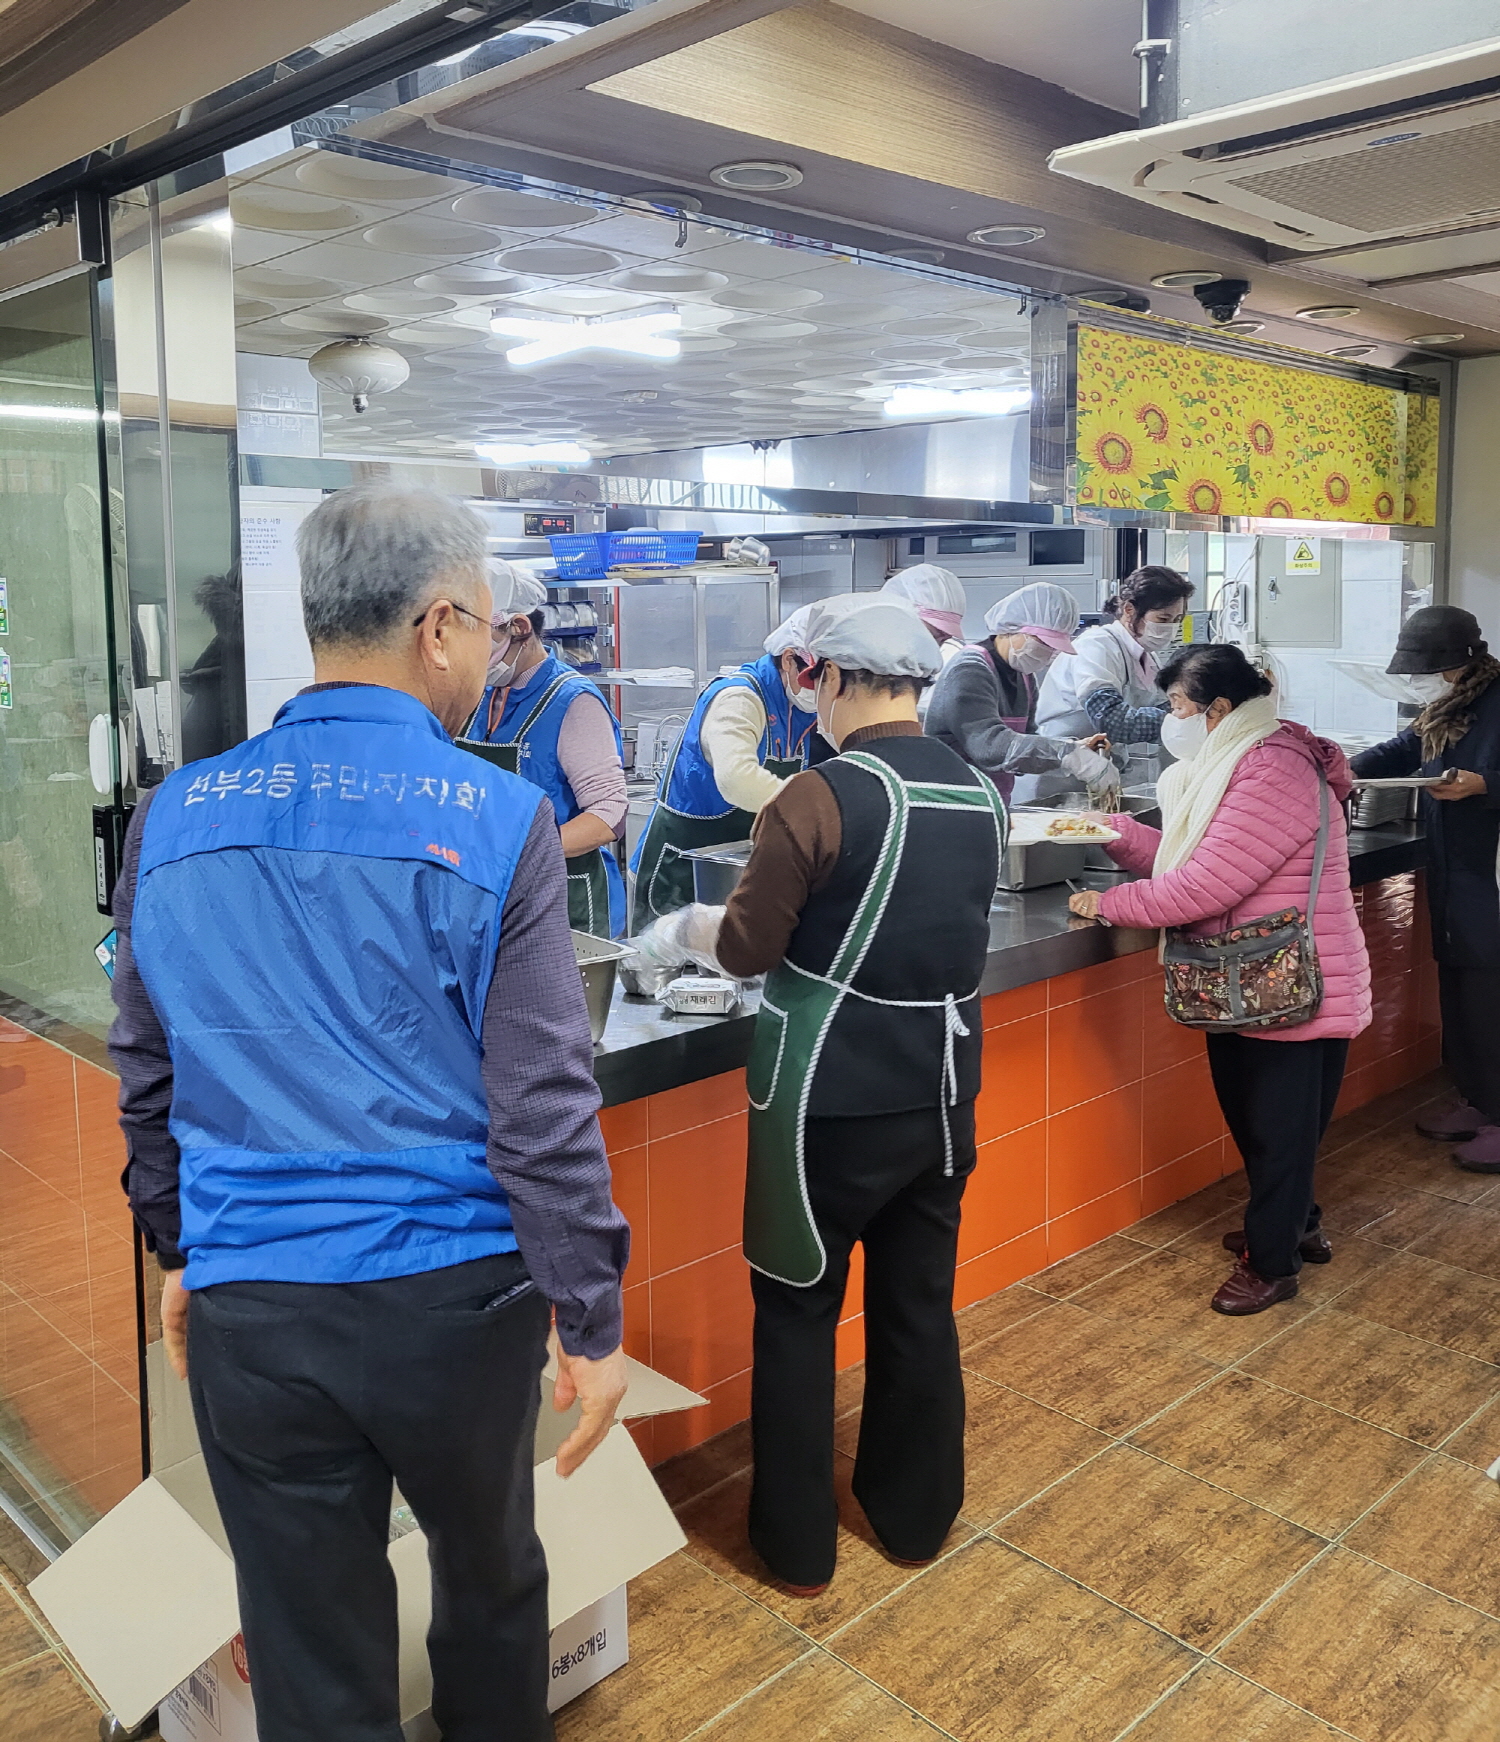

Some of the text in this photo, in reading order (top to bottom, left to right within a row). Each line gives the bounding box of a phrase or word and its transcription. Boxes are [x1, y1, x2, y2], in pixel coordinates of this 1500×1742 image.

[184, 763, 487, 820] 선부2동 주민자치회
[689, 995, 717, 1005] 재래김
